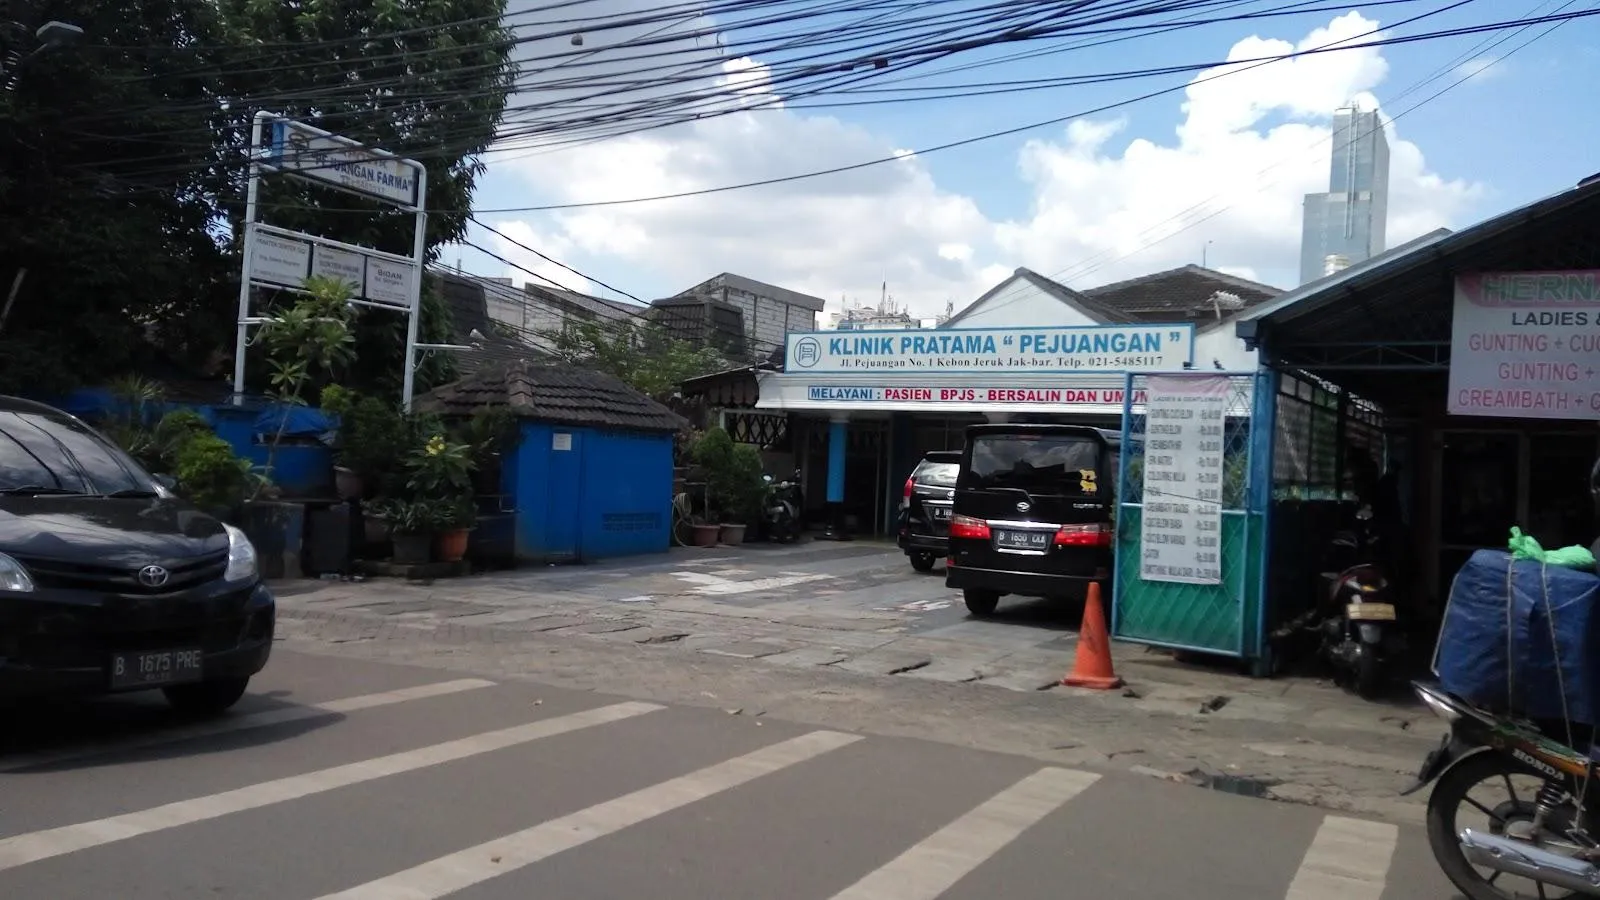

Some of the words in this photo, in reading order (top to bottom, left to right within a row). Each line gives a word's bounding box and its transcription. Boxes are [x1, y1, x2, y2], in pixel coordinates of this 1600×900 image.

[1482, 273, 1600, 303] HERN
[1512, 312, 1588, 326] LADIES
[829, 337, 894, 355] KLINIK
[900, 335, 996, 355] PRATAMA
[1019, 332, 1161, 354] PEJUANGAN
[1468, 333, 1548, 352] GUNTING
[1569, 334, 1600, 352] CU
[855, 359, 906, 369] Pejuangan
[909, 358, 925, 367] No.
[937, 358, 970, 367] Kebon
[973, 357, 1003, 367] Jeruk
[1007, 357, 1053, 367] Jak-bar.
[1057, 357, 1085, 369] Telp.
[1088, 356, 1163, 367] 021-5485117
[1498, 362, 1578, 381] GUNTING
[811, 388, 873, 400] MELAYANI
[884, 389, 932, 400] PASIEN
[940, 389, 975, 401] BPJS
[987, 389, 1061, 402] BERSALIN
[1066, 391, 1097, 402] DAN
[1458, 389, 1568, 409] CREAMBATH
[999, 532, 1005, 541] B
[115, 657, 125, 675] B
[138, 652, 171, 672] 1675
[176, 650, 201, 669] PRE
[1512, 748, 1565, 781] HONDA
